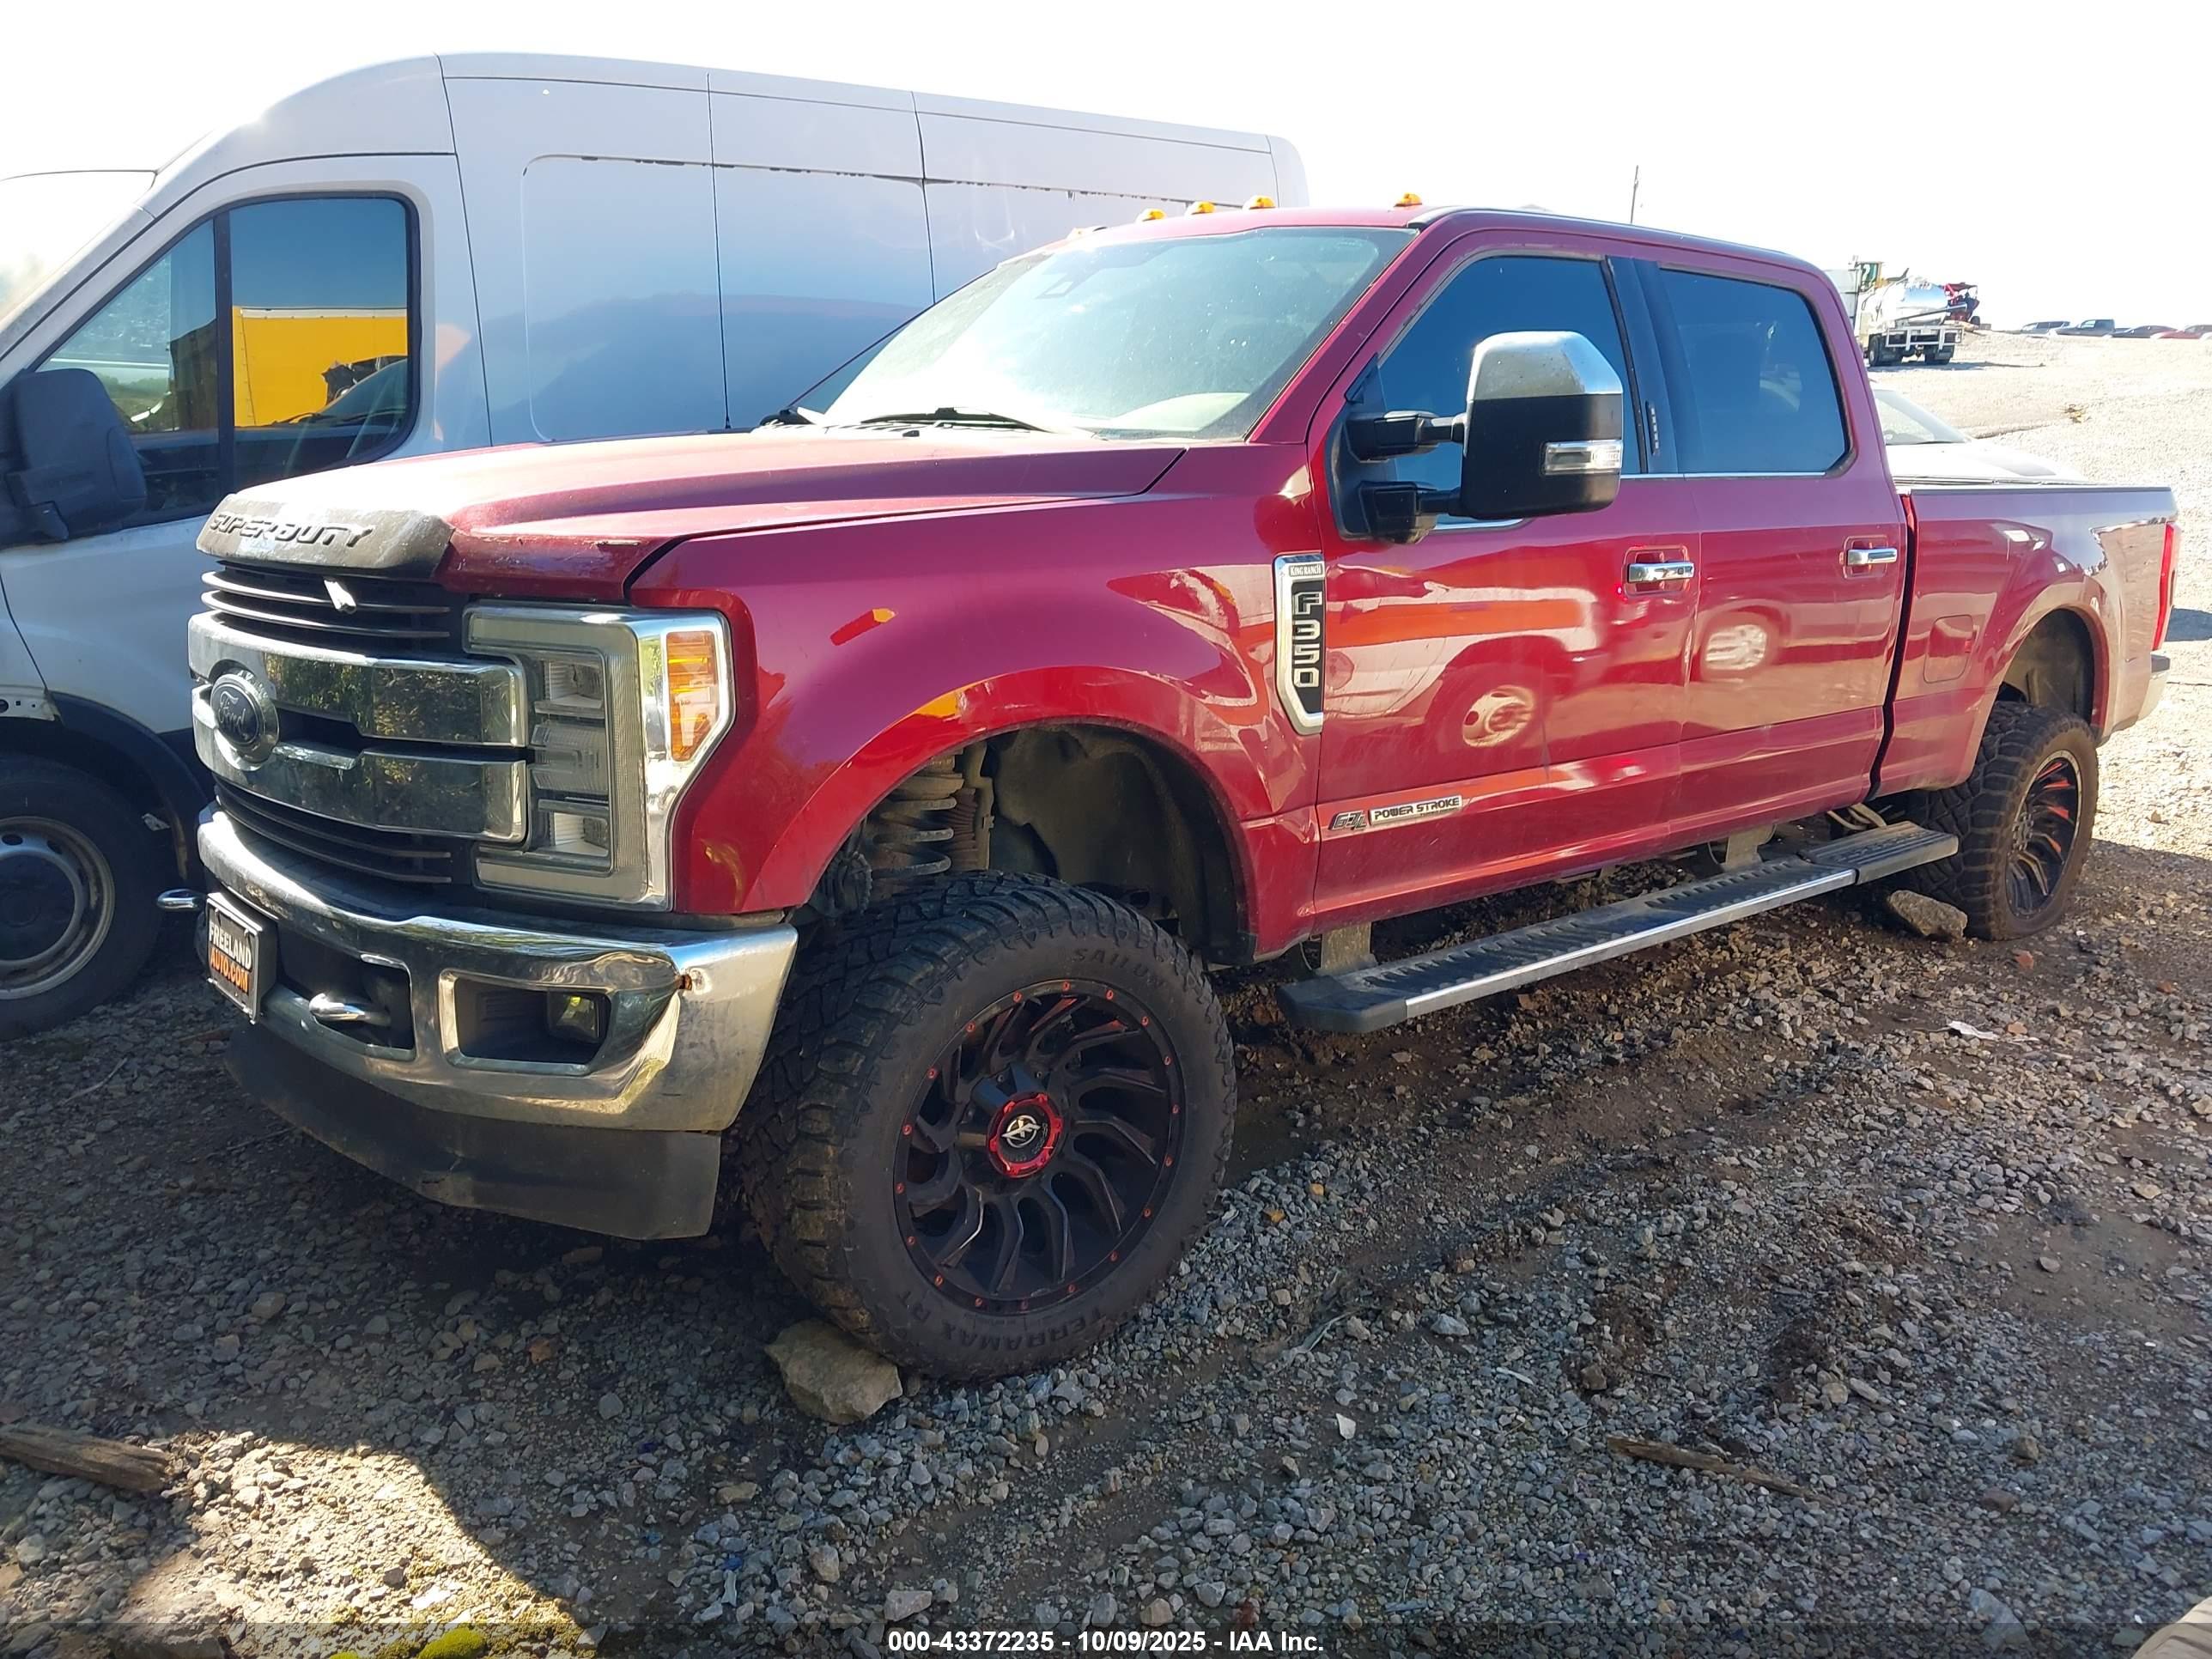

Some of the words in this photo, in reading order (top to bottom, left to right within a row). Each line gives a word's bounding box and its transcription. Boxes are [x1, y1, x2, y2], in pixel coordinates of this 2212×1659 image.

[210, 514, 276, 538] SUPER
[277, 523, 375, 548] DUTY
[1290, 565, 1304, 576] KING
[1304, 563, 1322, 575] RANCH
[1293, 591, 1322, 687] F350
[218, 690, 247, 737] Ford
[1374, 805, 1414, 820] POWER
[1416, 797, 1461, 812] STROKE
[209, 921, 252, 971] FREELAND
[210, 946, 250, 994] AUTO.COM
